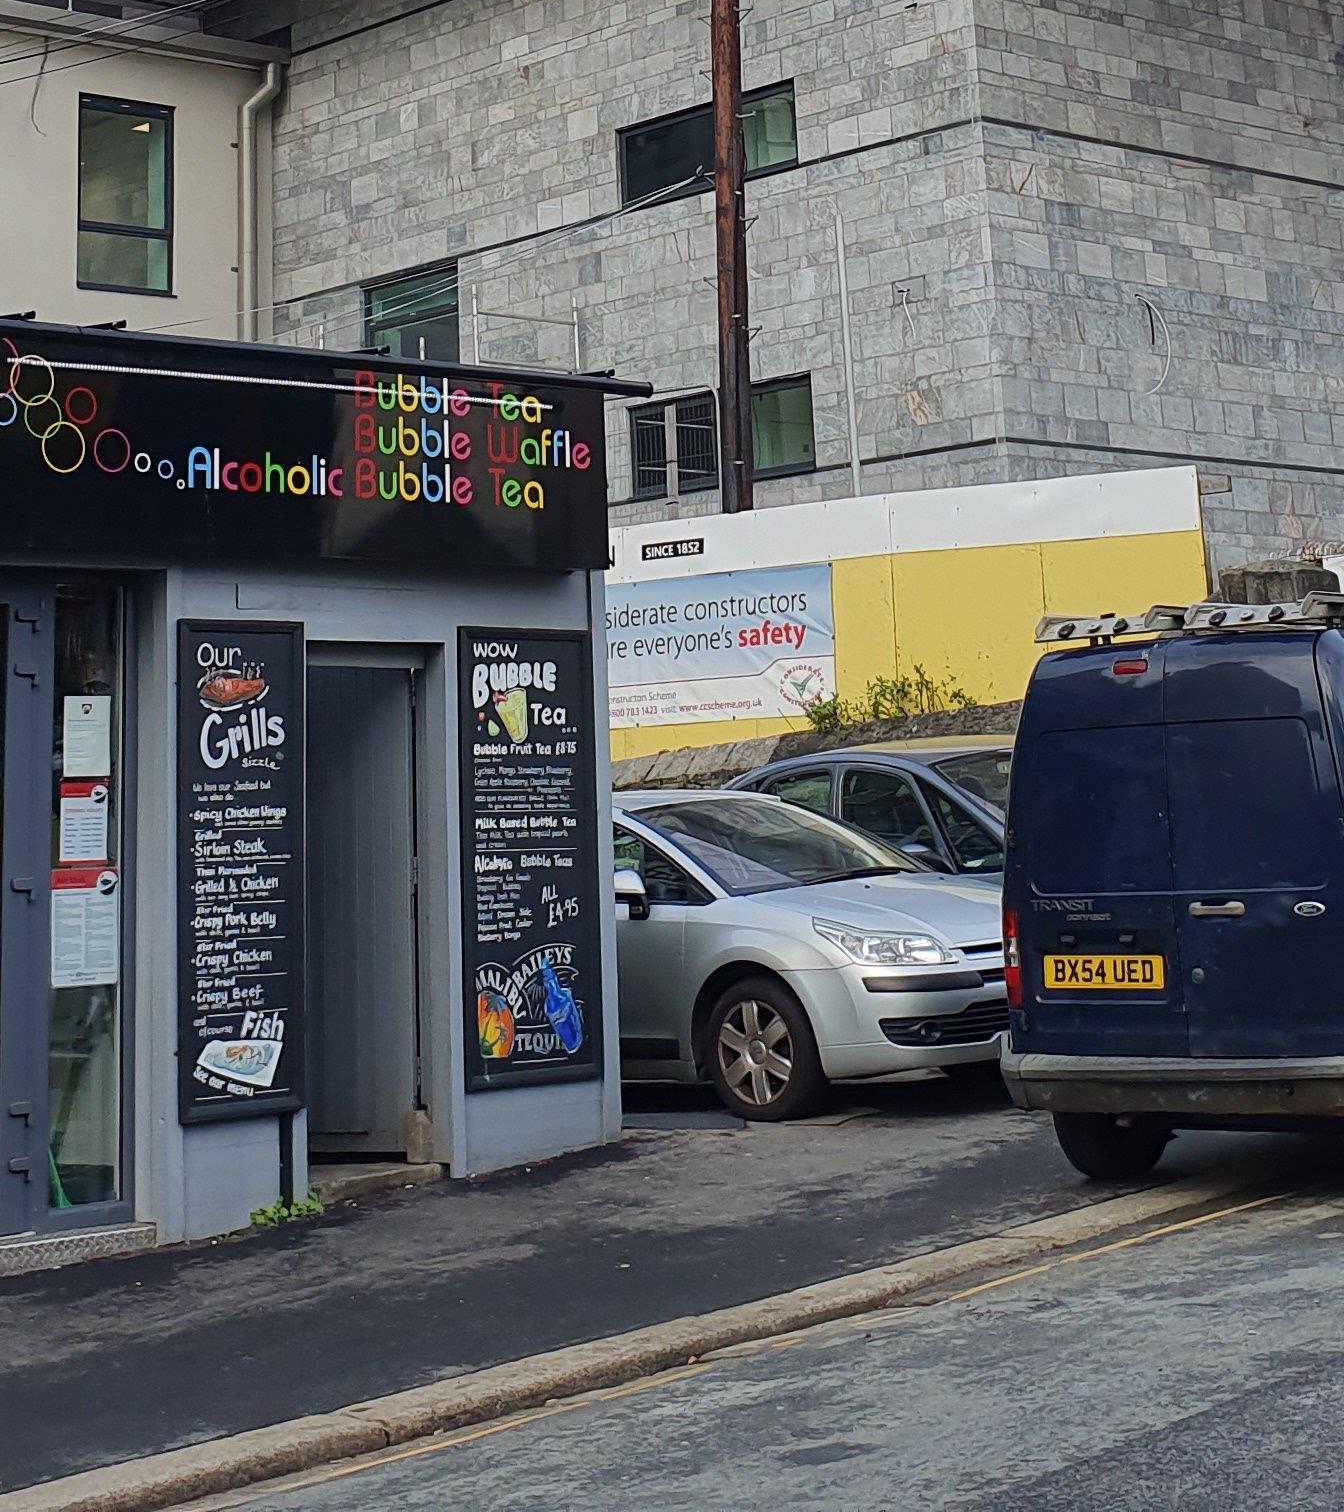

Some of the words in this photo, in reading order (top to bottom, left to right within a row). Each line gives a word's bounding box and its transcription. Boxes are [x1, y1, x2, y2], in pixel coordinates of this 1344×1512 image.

[355, 370, 471, 417] Bubble
[486, 381, 542, 424] Tea
[355, 413, 472, 461] Bubble
[487, 423, 591, 470] Waffle
[188, 446, 343, 497] Alcoholic
[355, 457, 473, 506] Bubble
[487, 467, 544, 510] Tea
[645, 544, 675, 559] SINCE
[676, 541, 700, 555] 1852
[683, 591, 807, 621] constructors
[606, 640, 628, 660] re
[633, 625, 733, 660] everyone's
[738, 619, 806, 650] safety
[473, 642, 519, 659] WOW
[472, 661, 557, 709] BUBBLE
[199, 707, 286, 769] Grills
[473, 743, 508, 756] Bubble
[510, 742, 533, 755] Fruit
[535, 742, 552, 755] Tea
[224, 805, 260, 820] Chicken
[499, 815, 528, 829] Based
[529, 815, 558, 828] Bubble
[561, 816, 577, 827] Tea
[194, 841, 231, 857] Sirloin
[233, 836, 268, 854] Steak
[520, 854, 552, 868] Bubble
[552, 853, 574, 867] Teas
[240, 875, 279, 891] Chicken
[1030, 899, 1095, 912] TRANSIT
[224, 911, 249, 926] Pork
[250, 910, 277, 929] Belly
[233, 948, 273, 964] Chicken
[511, 946, 573, 991] BAILEYS
[1053, 959, 1106, 983] BX54
[1113, 958, 1154, 983] UED
[232, 983, 264, 1000] Beef
[239, 1010, 285, 1041] Fish
